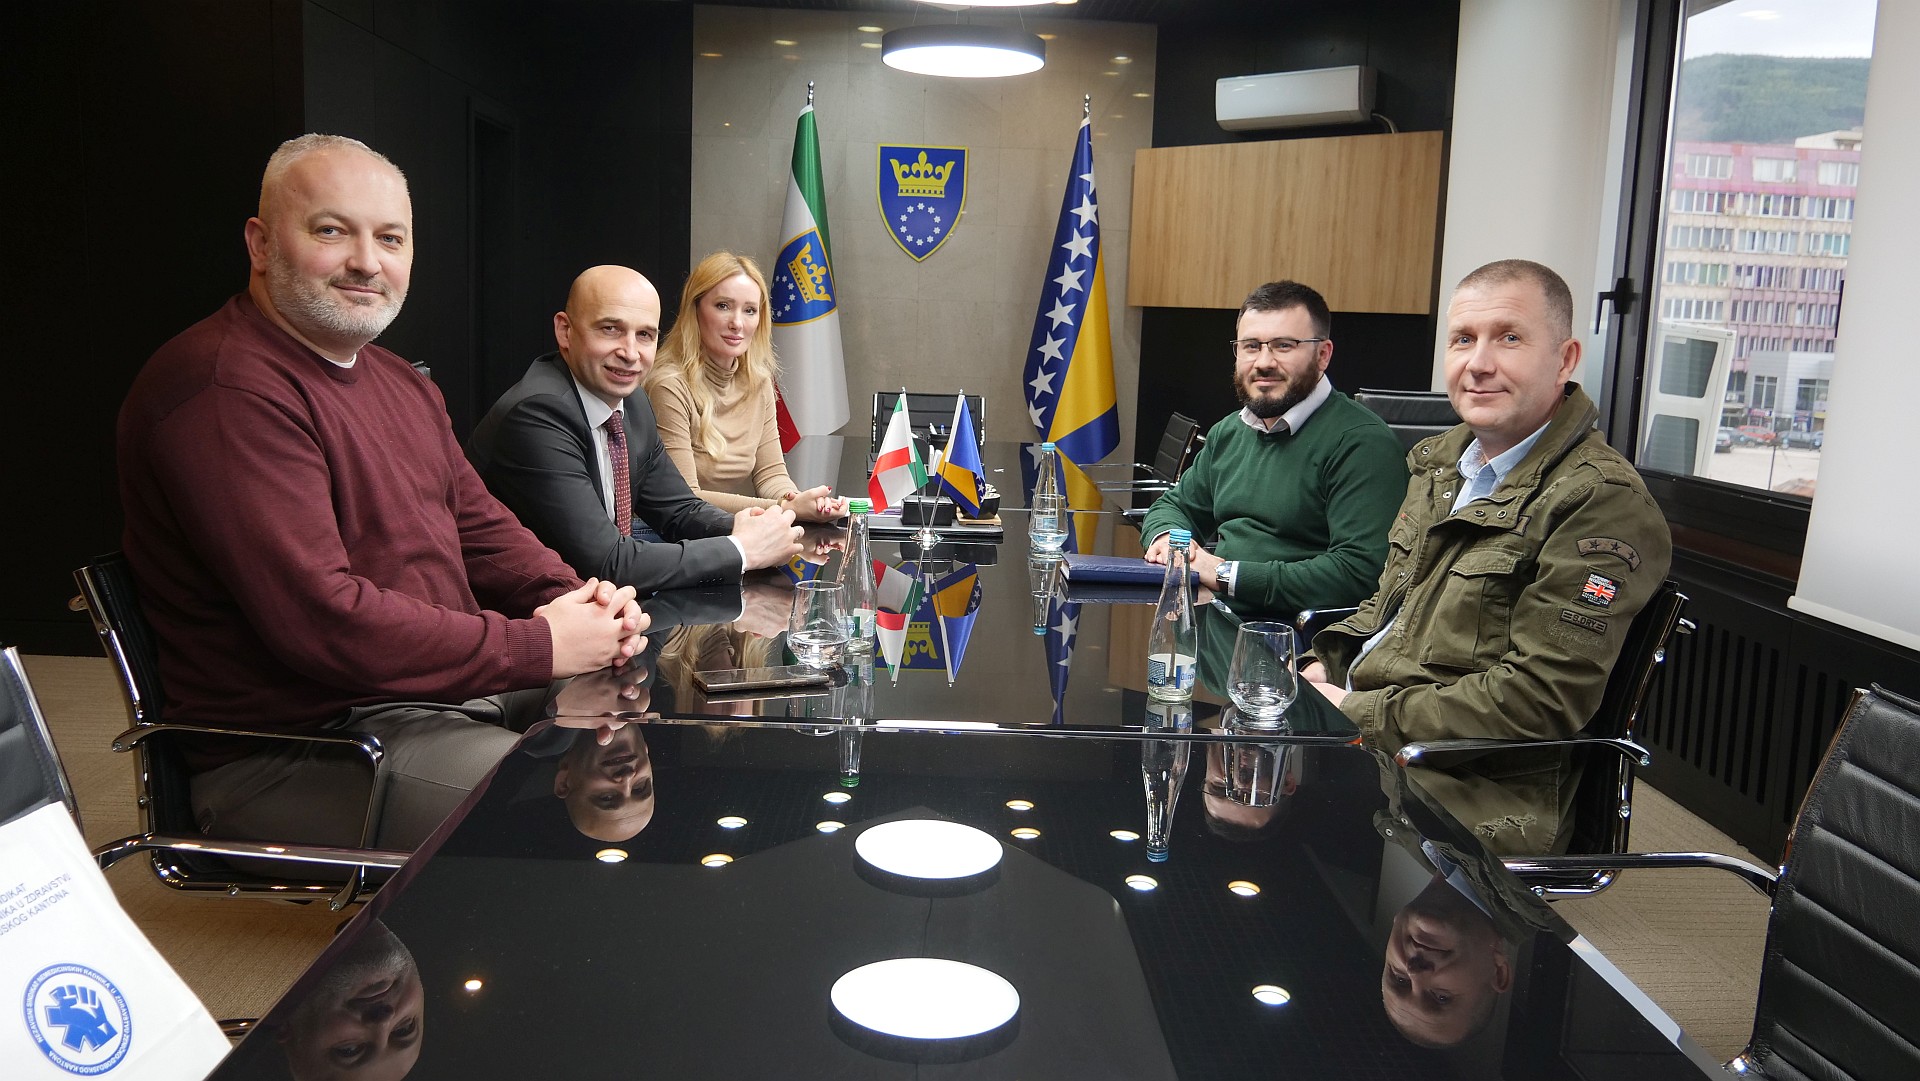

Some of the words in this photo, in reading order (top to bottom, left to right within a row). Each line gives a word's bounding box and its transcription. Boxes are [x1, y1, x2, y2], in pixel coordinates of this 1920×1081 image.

[1572, 614, 1597, 628] S.DRY
[15, 899, 25, 909] U
[27, 888, 69, 917] KANTONA
